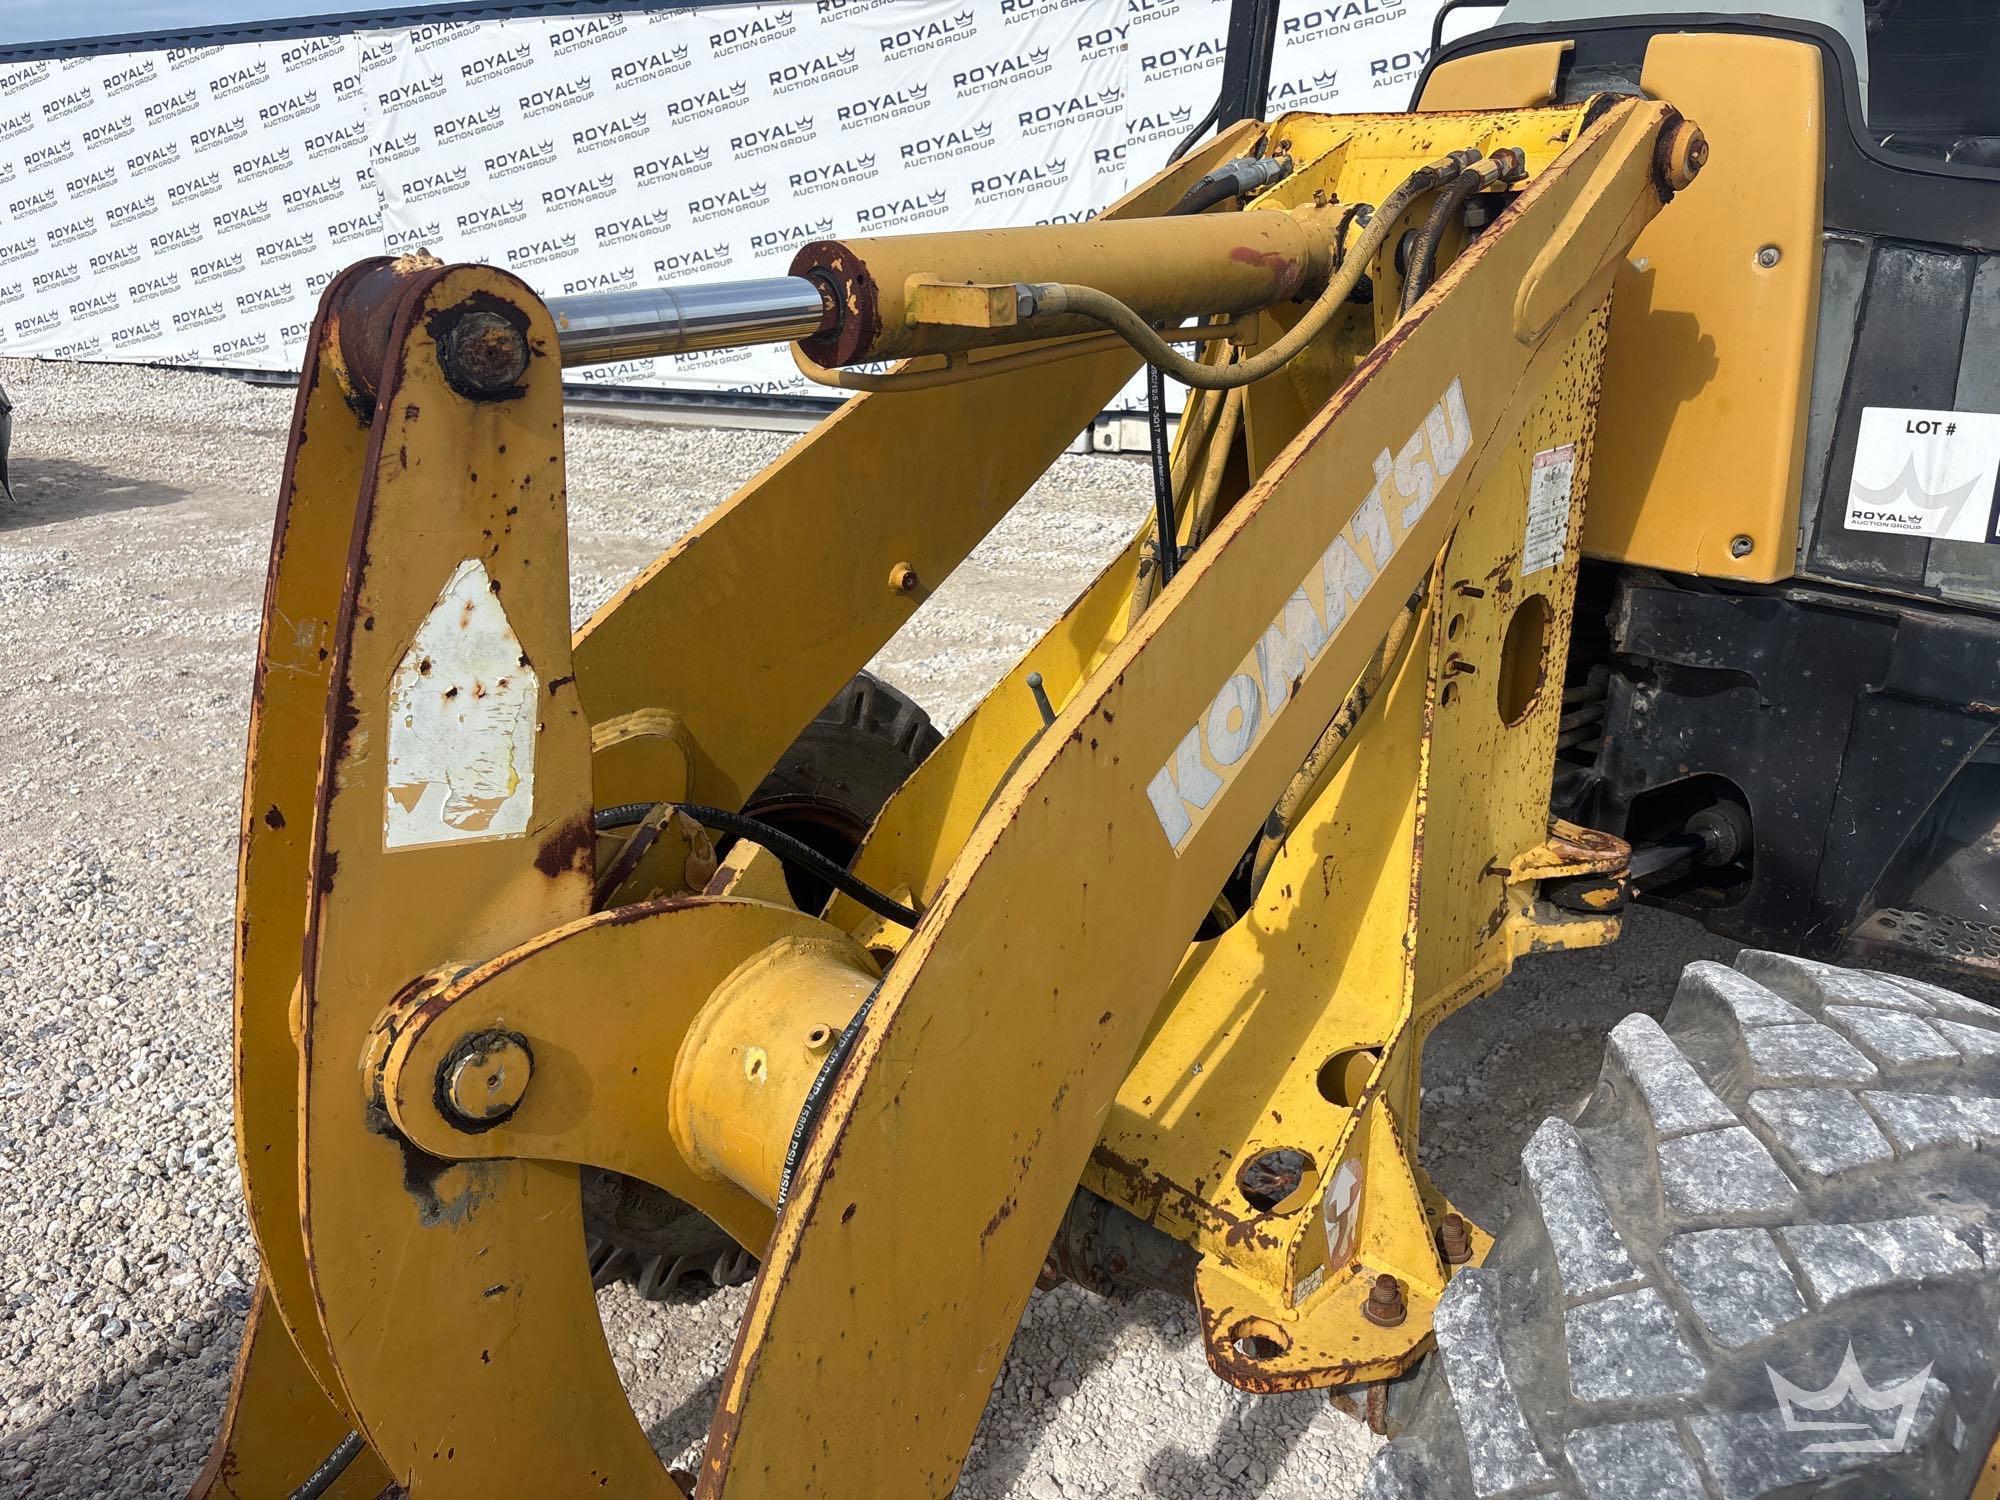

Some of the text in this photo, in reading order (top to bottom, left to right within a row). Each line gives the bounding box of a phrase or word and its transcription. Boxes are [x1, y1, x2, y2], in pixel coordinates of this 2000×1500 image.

[820, 5, 869, 25] AUCTION
[1004, 4, 1058, 26] AUCTION
[1133, 5, 1180, 26] GROUP
[1284, 0, 1379, 35] ROYAL
[1286, 8, 1407, 47] AUCTION GROUP
[549, 19, 609, 48] ROYAL
[554, 26, 627, 57] AUCTION GROUP
[709, 18, 776, 49] ROYAL
[714, 26, 796, 59] AUCTION GROUP
[880, 19, 955, 52] ROYAL
[884, 28, 977, 63] AUCTION GROUP
[1077, 23, 1130, 51] ROY
[461, 50, 517, 78] ROYAL
[466, 58, 534, 87] AUCTION GROUP
[611, 52, 673, 81] ROYAL
[769, 55, 838, 86] ROYAL
[953, 56, 1029, 88] ROYAL
[1144, 61, 1203, 84] AUCTION
[1370, 47, 1431, 76] ROY
[103, 66, 144, 90] ROYAL
[209, 67, 255, 93] ROYAL
[615, 60, 692, 91] AUCTION GROUP
[773, 64, 859, 96] AUCTION GROUP
[957, 64, 1052, 99] AUCTION GROUP
[42, 92, 82, 115] ROYAL
[378, 80, 431, 106] ROYAL
[383, 88, 447, 115] AUCTION GROUP
[519, 83, 577, 110] ROYAL
[667, 88, 730, 117] ROYAL
[1267, 79, 1313, 101] YAL
[1288, 89, 1339, 109] GROUP
[259, 96, 306, 121] ROYAL
[524, 91, 595, 120] AUCTION GROUP
[672, 97, 750, 127] AUCTION GROUP
[837, 91, 909, 121] ROYAL
[841, 100, 931, 131] AUCTION GROUP
[1018, 95, 1098, 127] ROYAL
[433, 112, 488, 138] ROYAL
[438, 120, 504, 146] AUCTION GROUP
[572, 118, 632, 145] ROYAL
[1022, 104, 1122, 137] AUCTION GROUP
[1126, 113, 1170, 135] YAL
[1148, 123, 1194, 141] GROUP
[304, 127, 353, 152] ROYAL
[577, 127, 650, 155] AUCTION GROUP
[730, 123, 797, 151] ROYAL
[734, 132, 817, 161] AUCTION GROUP
[900, 129, 974, 159] ROYAL
[484, 146, 540, 171] ROYAL
[633, 152, 694, 179] ROYAL
[904, 138, 996, 169] AUCTION GROUP
[489, 155, 557, 180] AUCTION GROUP
[638, 161, 713, 188] AUCTION GROUP
[789, 160, 858, 188] ROYAL
[971, 166, 1046, 195] ROYAL
[66, 171, 106, 193] ROYAL
[282, 183, 330, 205] ROYAL
[402, 172, 454, 196] ROYAL
[406, 180, 471, 204] AUCTION GROUP
[542, 180, 599, 204] ROYAL
[793, 169, 879, 198] AUCTION GROUP
[975, 175, 1069, 205] AUCTION GROUP
[546, 188, 617, 213] AUCTION GROUP
[688, 189, 751, 215] ROYAL
[693, 197, 770, 224] AUCTION GROUP
[857, 196, 928, 223] ROYAL
[457, 204, 511, 228] ROYAL
[461, 213, 527, 236] AUCTION GROUP
[595, 215, 654, 239] ROYAL
[861, 205, 949, 233] AUCTION GROUP
[150, 228, 191, 248] ROYAL
[599, 223, 671, 248] AUCTION GROUP
[750, 224, 816, 249] ROYAL
[507, 239, 562, 262] ROYAL
[511, 248, 579, 271] AUCTION GROUP
[654, 249, 715, 273] ROYAL
[754, 242, 798, 258] AUCTION
[563, 272, 620, 295] ROYAL
[658, 258, 733, 282] AUCTION GROUP
[236, 287, 281, 307] ROYAL
[1906, 420, 1957, 436] LOT #
[1851, 510, 1907, 523] ROYAL
[1851, 519, 1921, 530] AUCTION GROUP
[1146, 374, 1473, 850] KOMATSU
[808, 1075, 825, 1101] MPa
[794, 1104, 812, 1138] (5800
[785, 1140, 799, 1166] PSI)
[778, 1168, 791, 1204] MSHA
